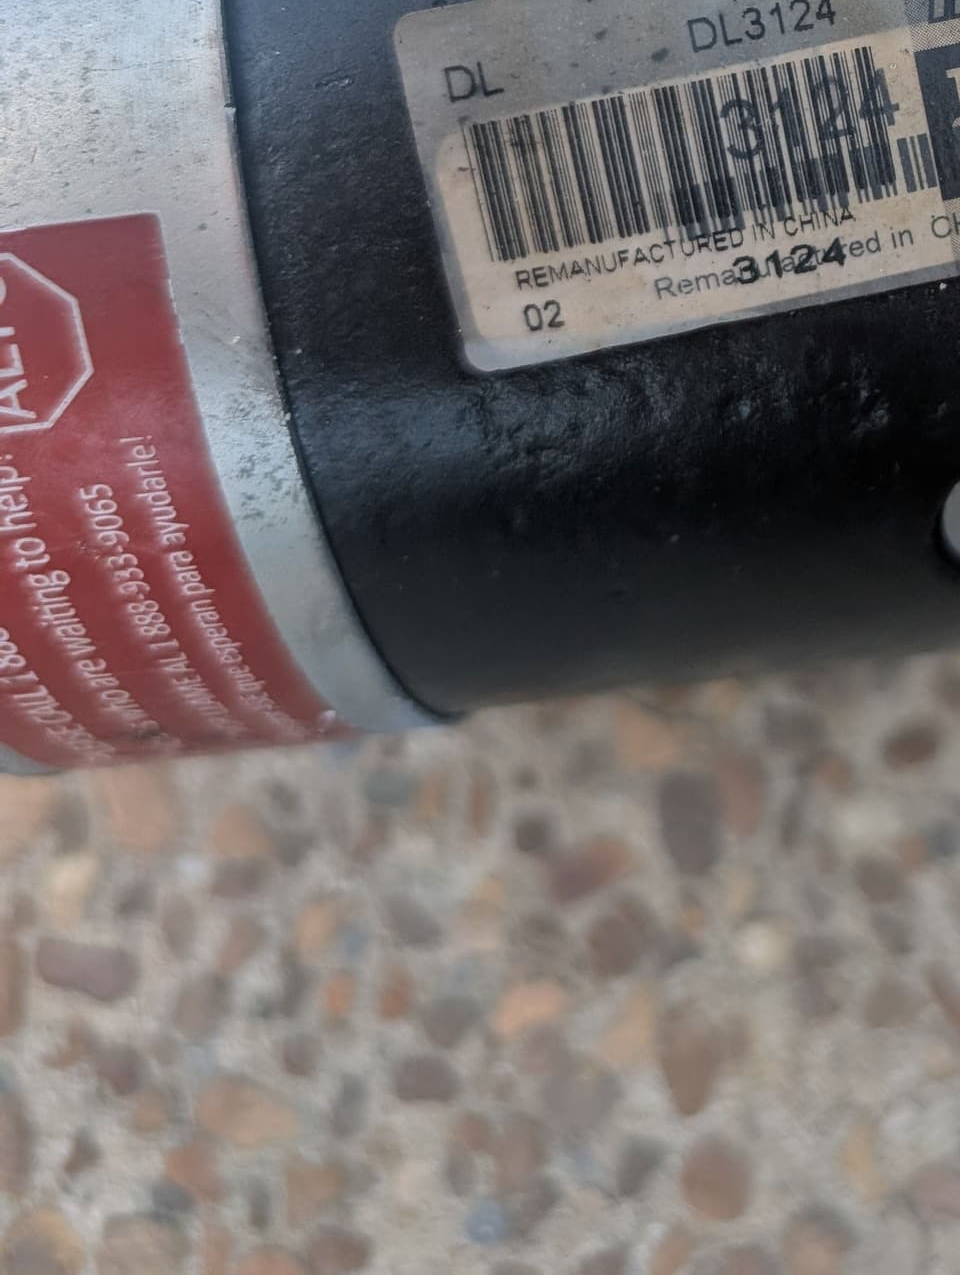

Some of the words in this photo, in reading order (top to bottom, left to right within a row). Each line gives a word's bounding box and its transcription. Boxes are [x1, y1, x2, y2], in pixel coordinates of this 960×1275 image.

[442, 61, 504, 103] DL
[514, 227, 744, 291] REMANUFACTURED
[752, 221, 776, 242] IN
[782, 205, 857, 238] CHINA
[891, 228, 914, 249] in
[732, 236, 847, 286] 3124
[522, 298, 566, 332] 02
[118, 434, 191, 546] ayudarle!
[14, 536, 51, 568] to
[78, 483, 172, 637] 888-933-9065
[167, 550, 217, 597] para
[28, 569, 96, 655] waiting
[189, 597, 243, 664] esperan
[76, 657, 121, 688] are
[156, 651, 196, 674] AL
[13, 684, 73, 725] CALL
